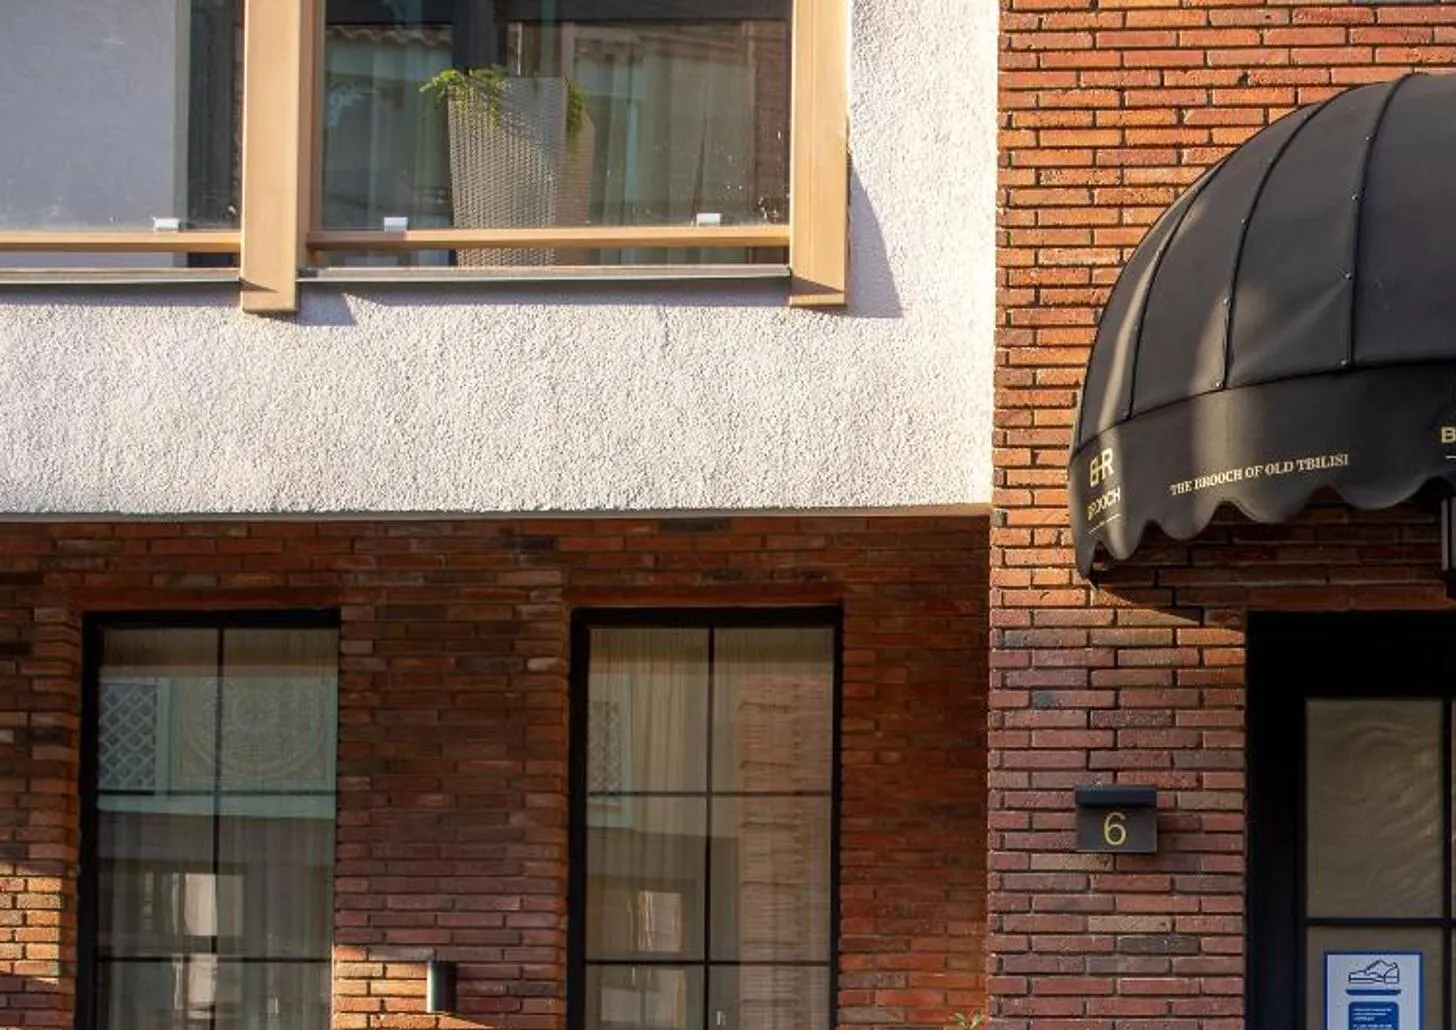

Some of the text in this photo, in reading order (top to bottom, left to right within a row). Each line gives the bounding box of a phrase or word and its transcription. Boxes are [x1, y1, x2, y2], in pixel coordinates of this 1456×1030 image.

[1170, 453, 1348, 496] THE BROOCH OF OLD TBILISI
[1103, 812, 1127, 846] 6
